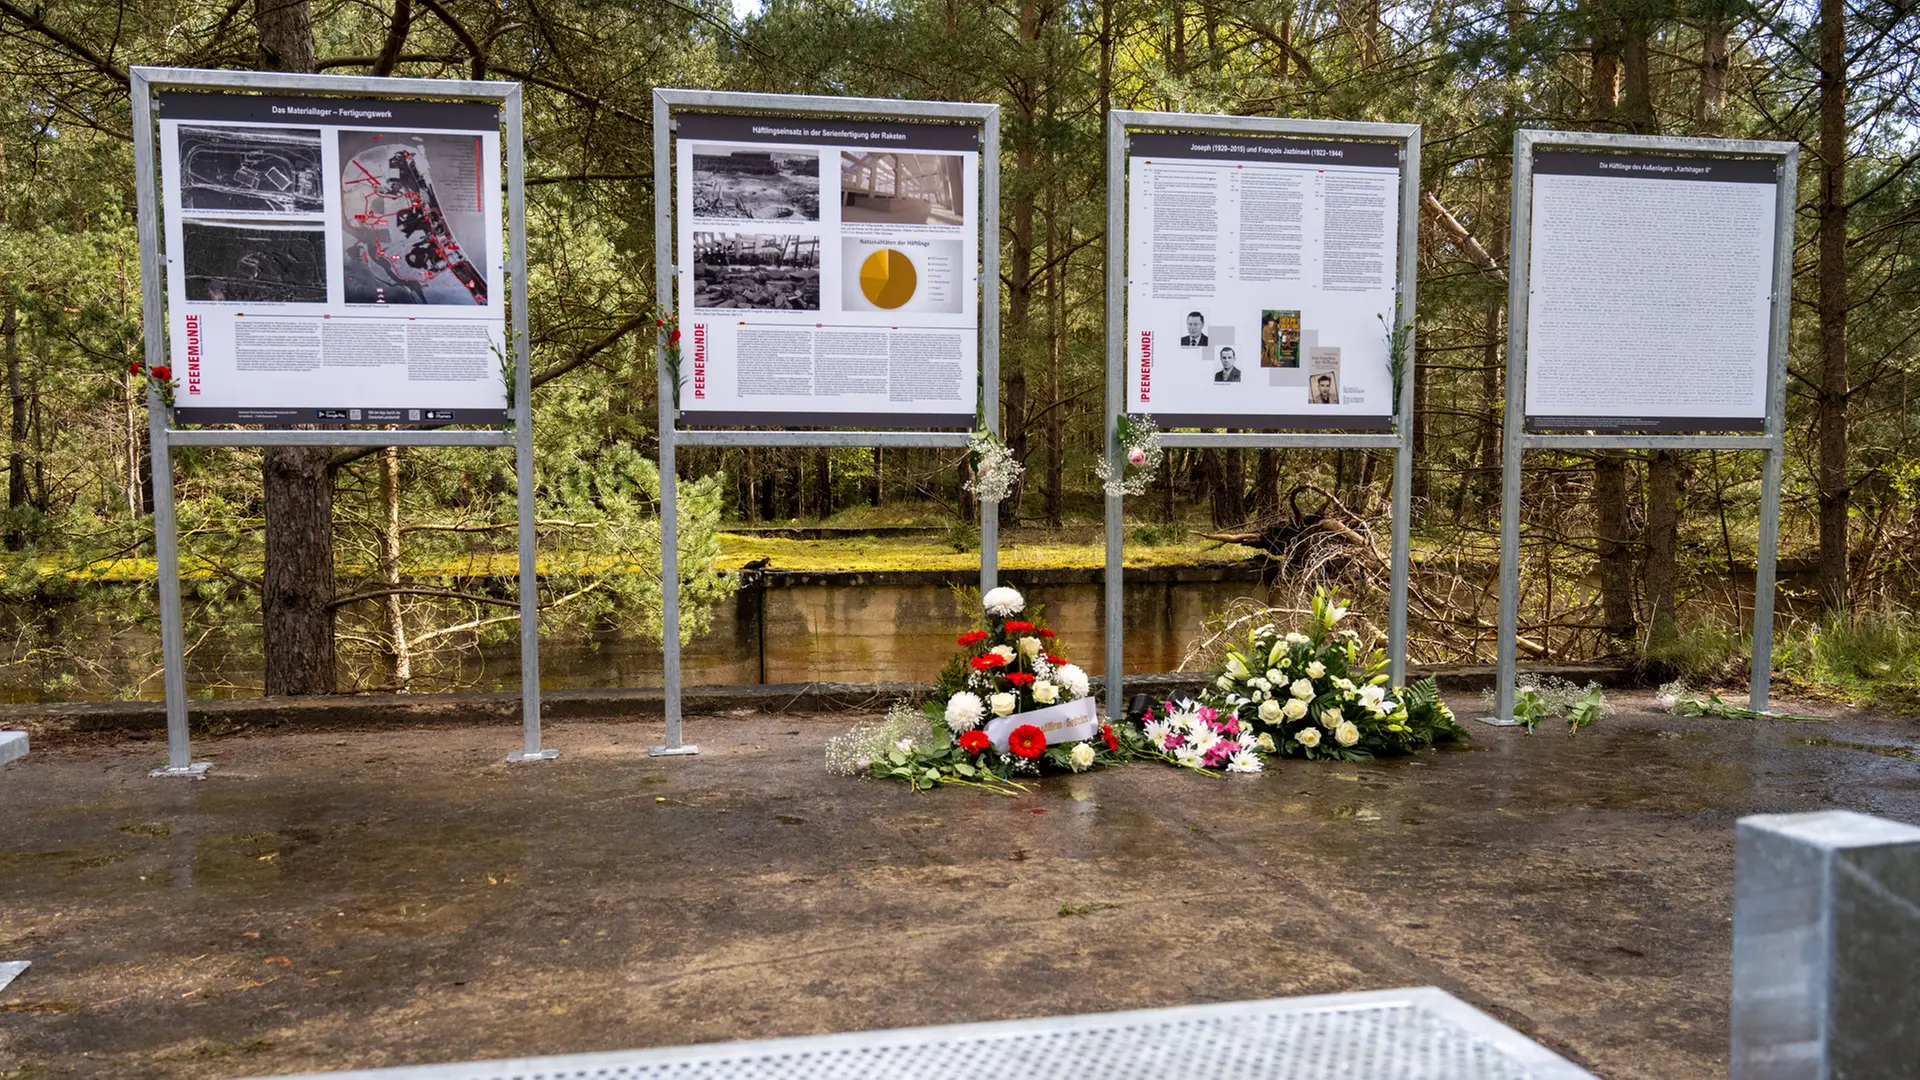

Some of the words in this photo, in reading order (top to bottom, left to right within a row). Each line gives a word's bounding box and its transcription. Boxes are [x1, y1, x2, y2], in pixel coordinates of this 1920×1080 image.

[272, 106, 286, 114] Das
[287, 106, 332, 117] Materiallager
[339, 108, 392, 119] Fertigungswerk
[752, 126, 802, 136] Häftlingseinsatz
[811, 128, 821, 137] der
[822, 129, 869, 140] Serienfertigung
[881, 132, 906, 140] Raketen
[1190, 144, 1211, 152] Joseph
[1258, 146, 1282, 155] François
[1609, 162, 1631, 171] Häftlinge
[1642, 164, 1673, 173] Außenlagers
